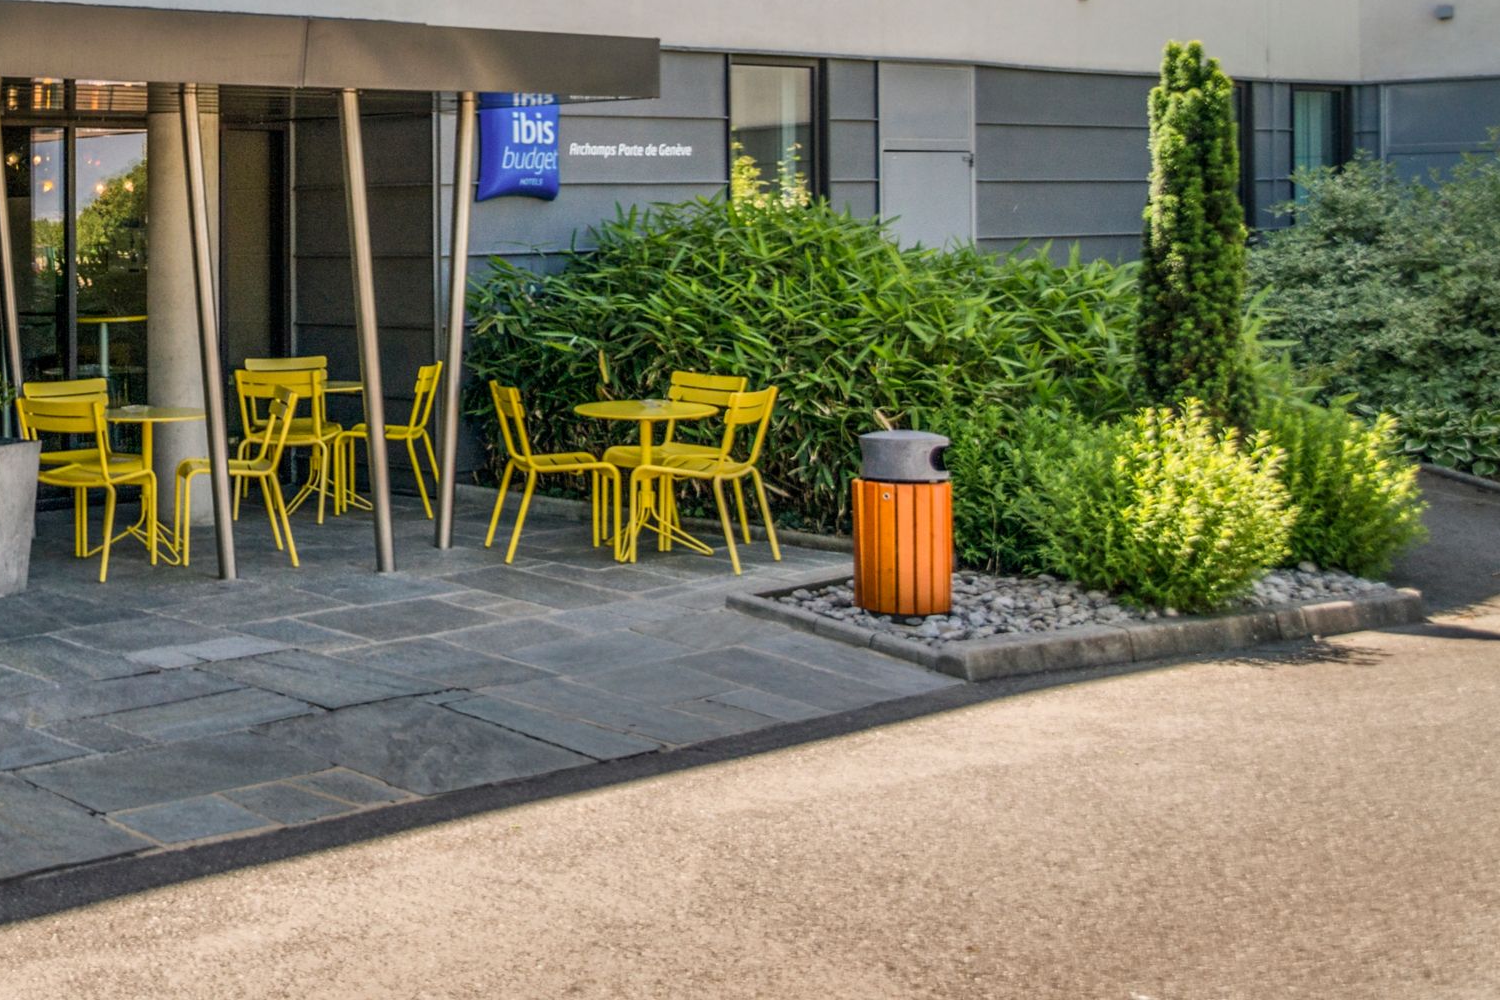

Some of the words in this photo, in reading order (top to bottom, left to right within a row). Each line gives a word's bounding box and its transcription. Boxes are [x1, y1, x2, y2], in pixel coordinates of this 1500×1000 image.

[512, 111, 555, 145] ibis
[502, 145, 559, 175] budget
[569, 142, 617, 159] Archamps
[617, 143, 644, 157] Porte
[644, 143, 658, 157] de
[658, 143, 693, 157] Genève
